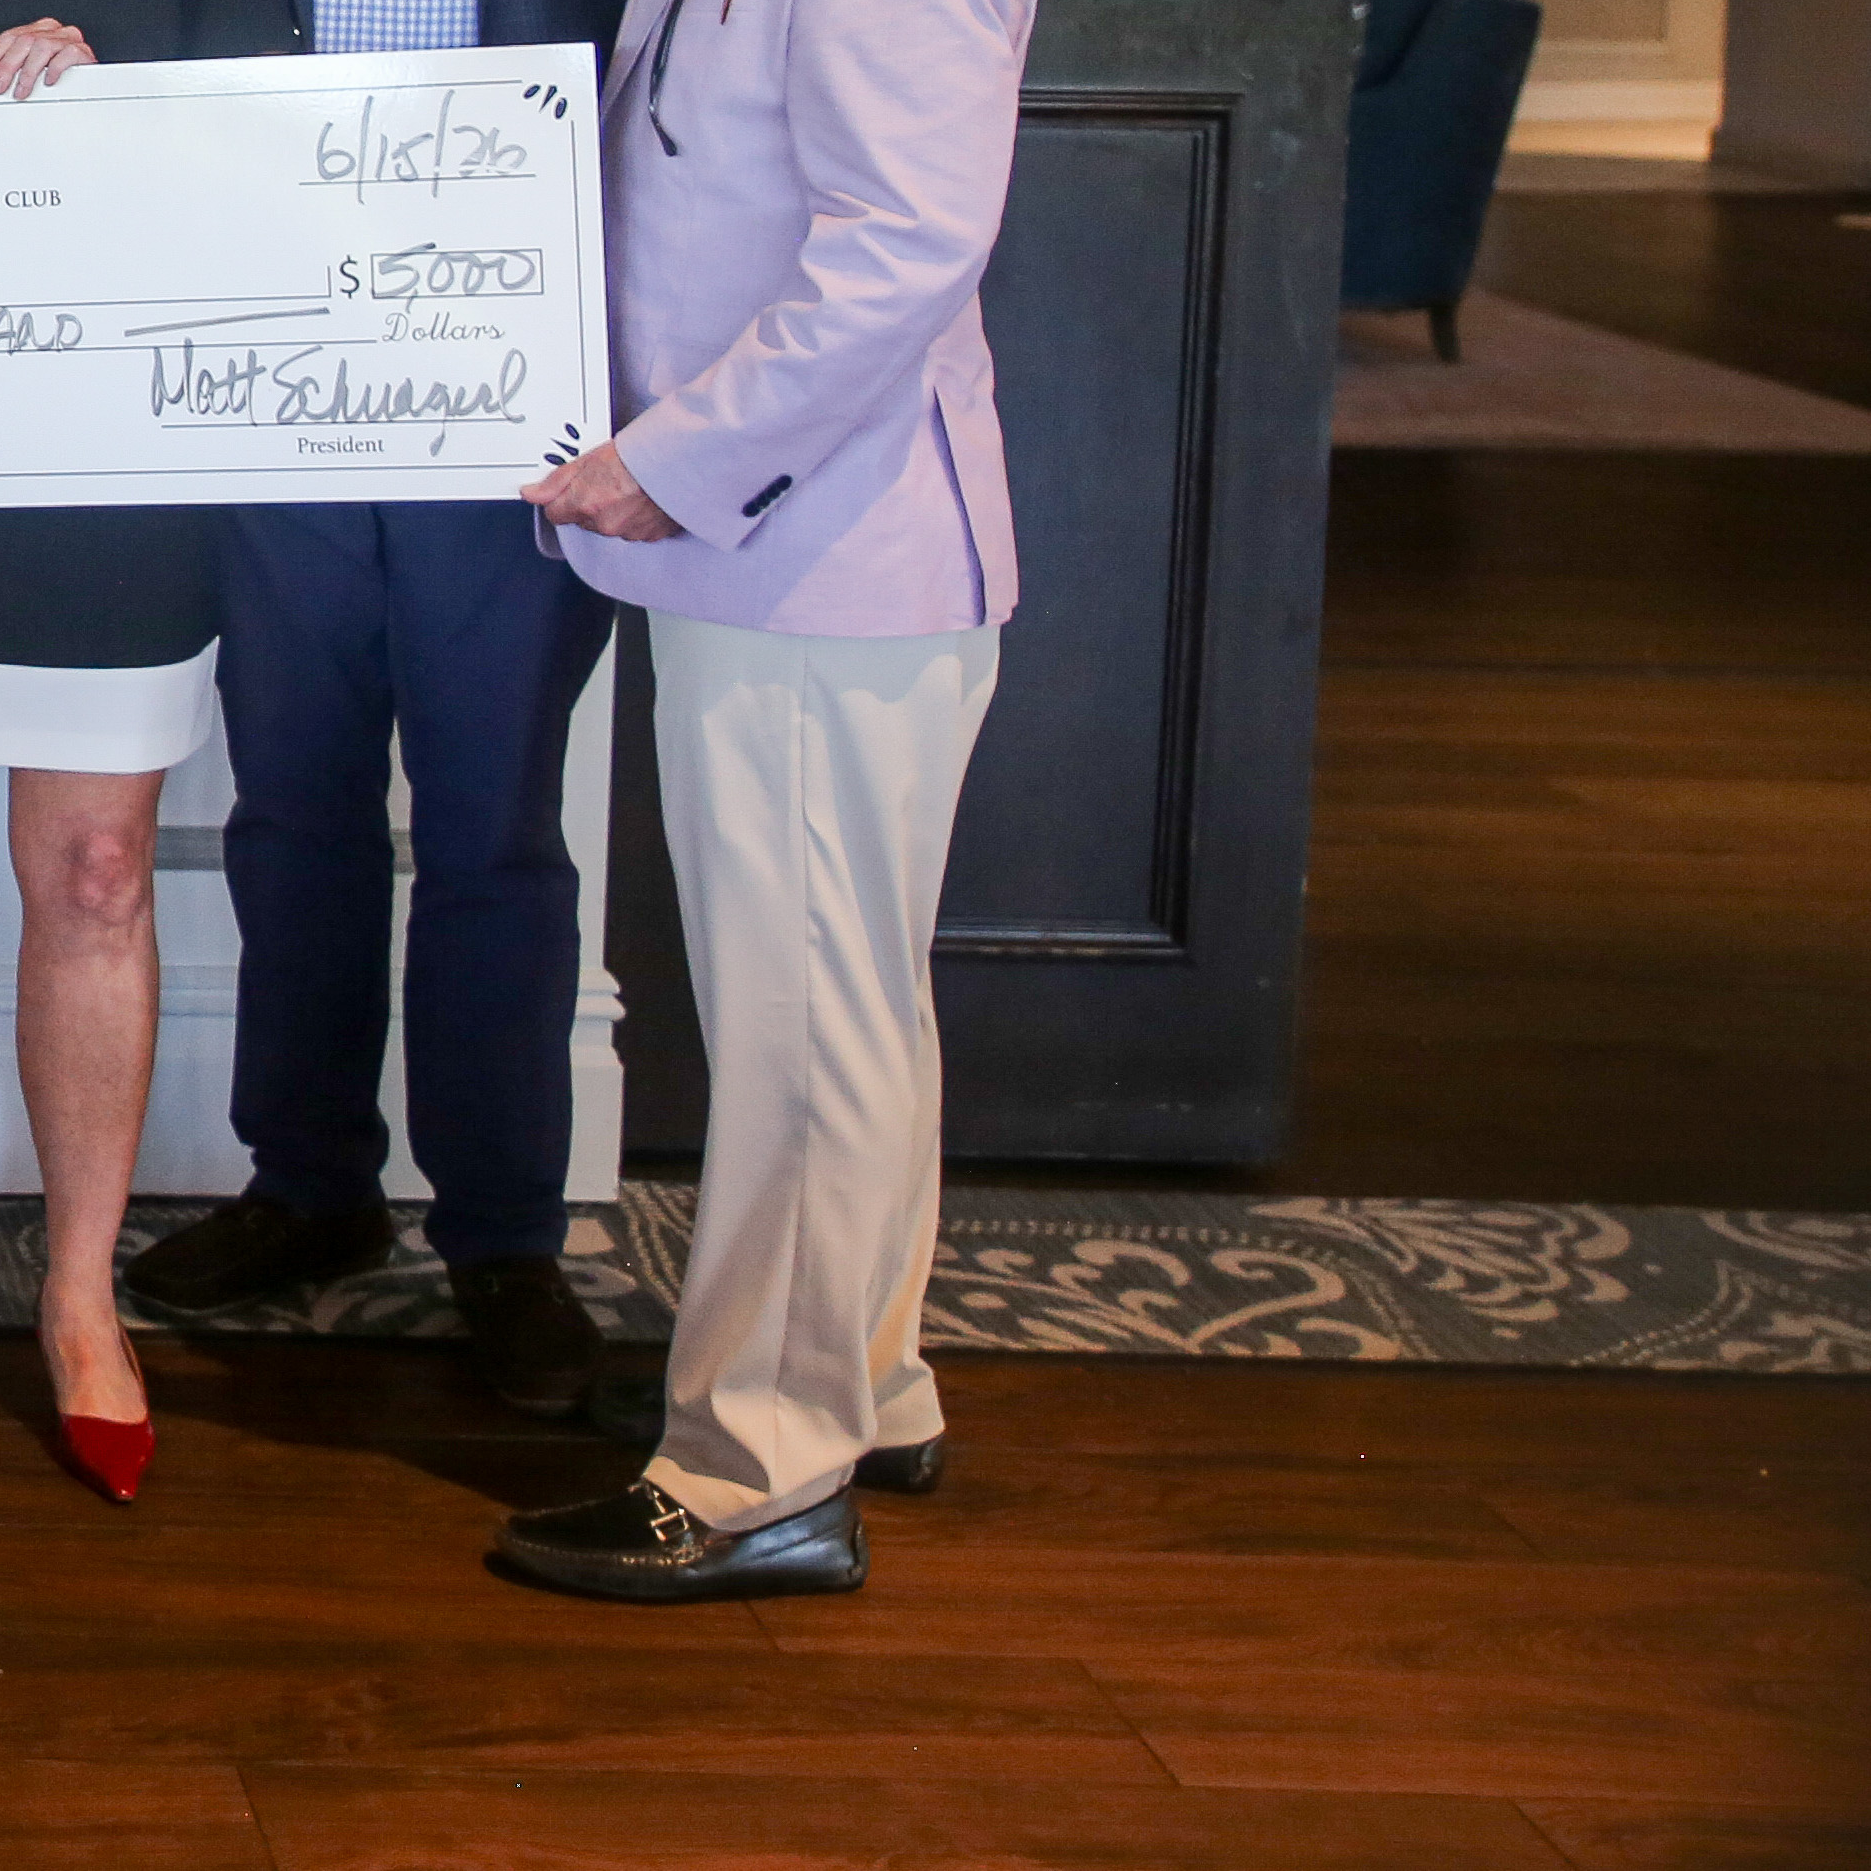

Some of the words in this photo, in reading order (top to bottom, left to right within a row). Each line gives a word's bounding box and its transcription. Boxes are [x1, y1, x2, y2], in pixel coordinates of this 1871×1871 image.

[316, 90, 527, 204] 6/15/26
[5, 189, 62, 208] CLUB
[338, 255, 360, 298] $
[382, 313, 505, 343] Dollars
[150, 337, 266, 426] Matt
[297, 435, 385, 455] President
